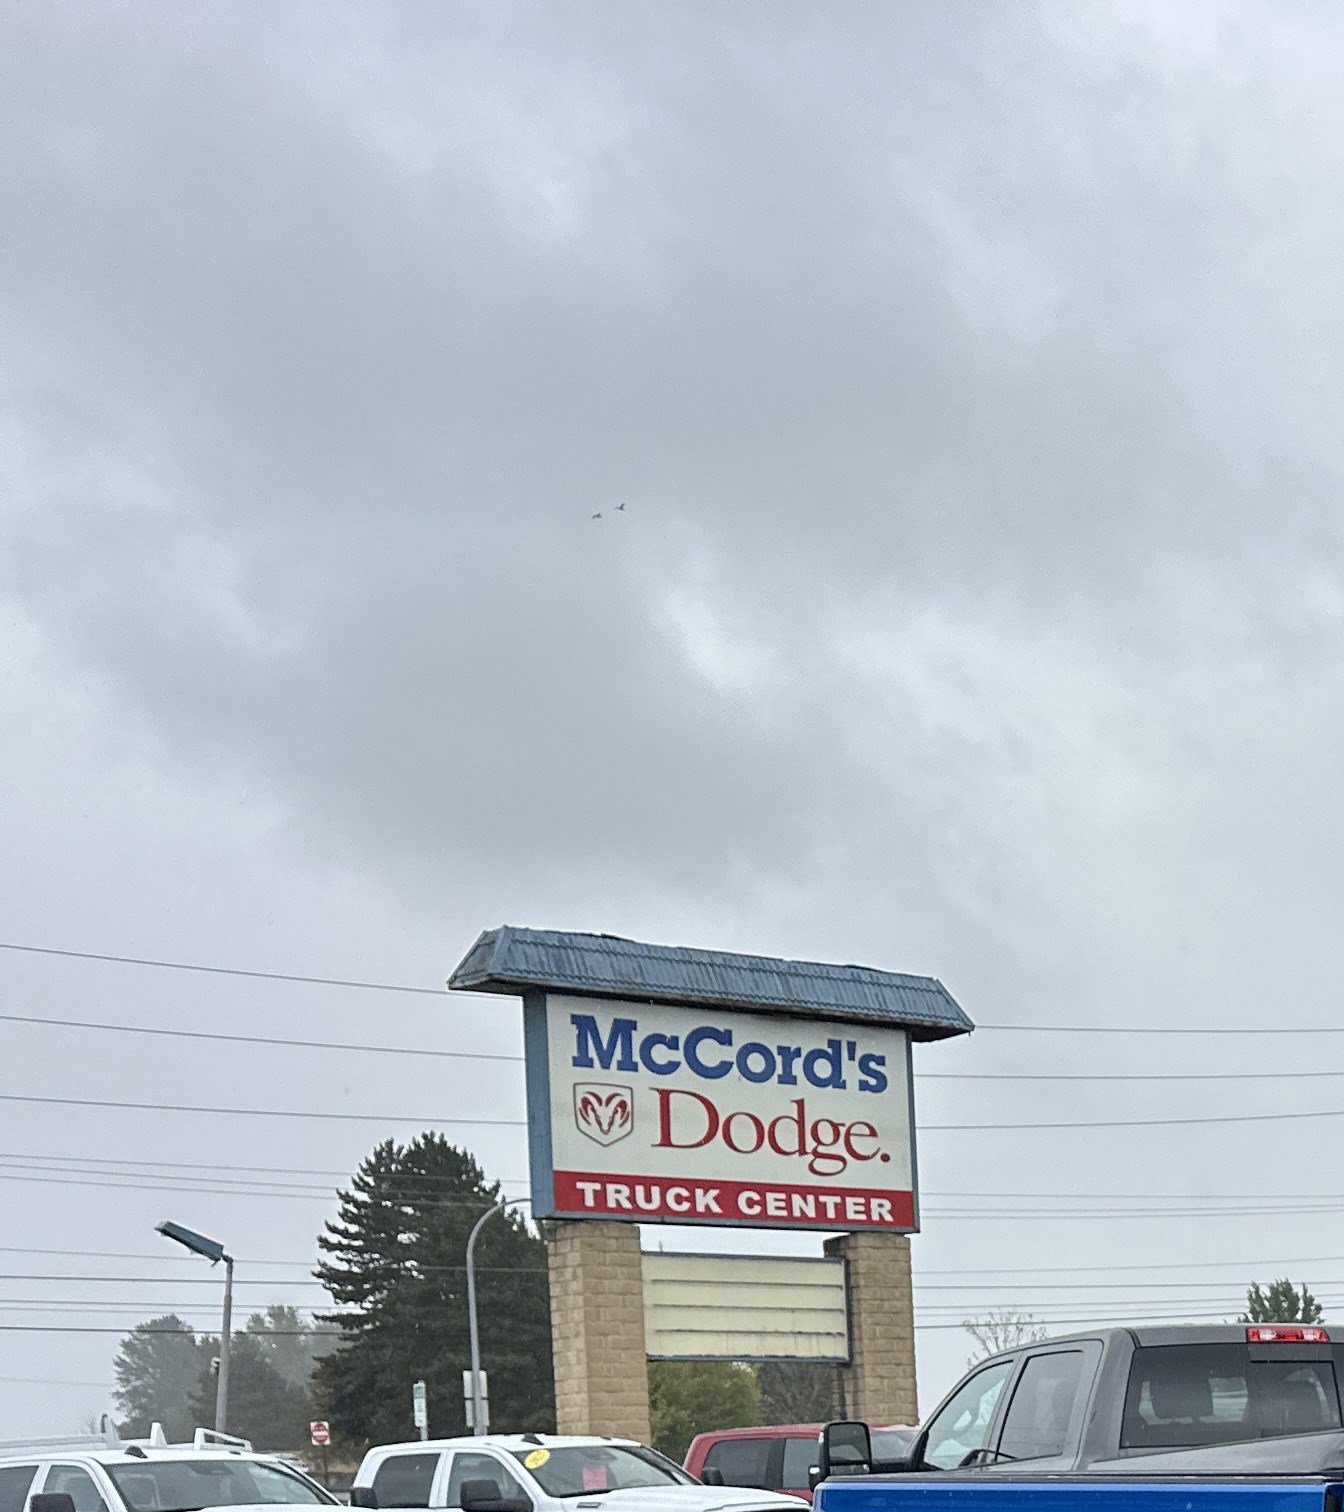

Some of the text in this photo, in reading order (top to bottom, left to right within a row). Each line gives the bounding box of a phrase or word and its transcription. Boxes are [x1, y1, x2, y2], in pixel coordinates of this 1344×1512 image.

[570, 1013, 888, 1093] McCord's
[576, 1180, 894, 1222] TRUCK CENTER
